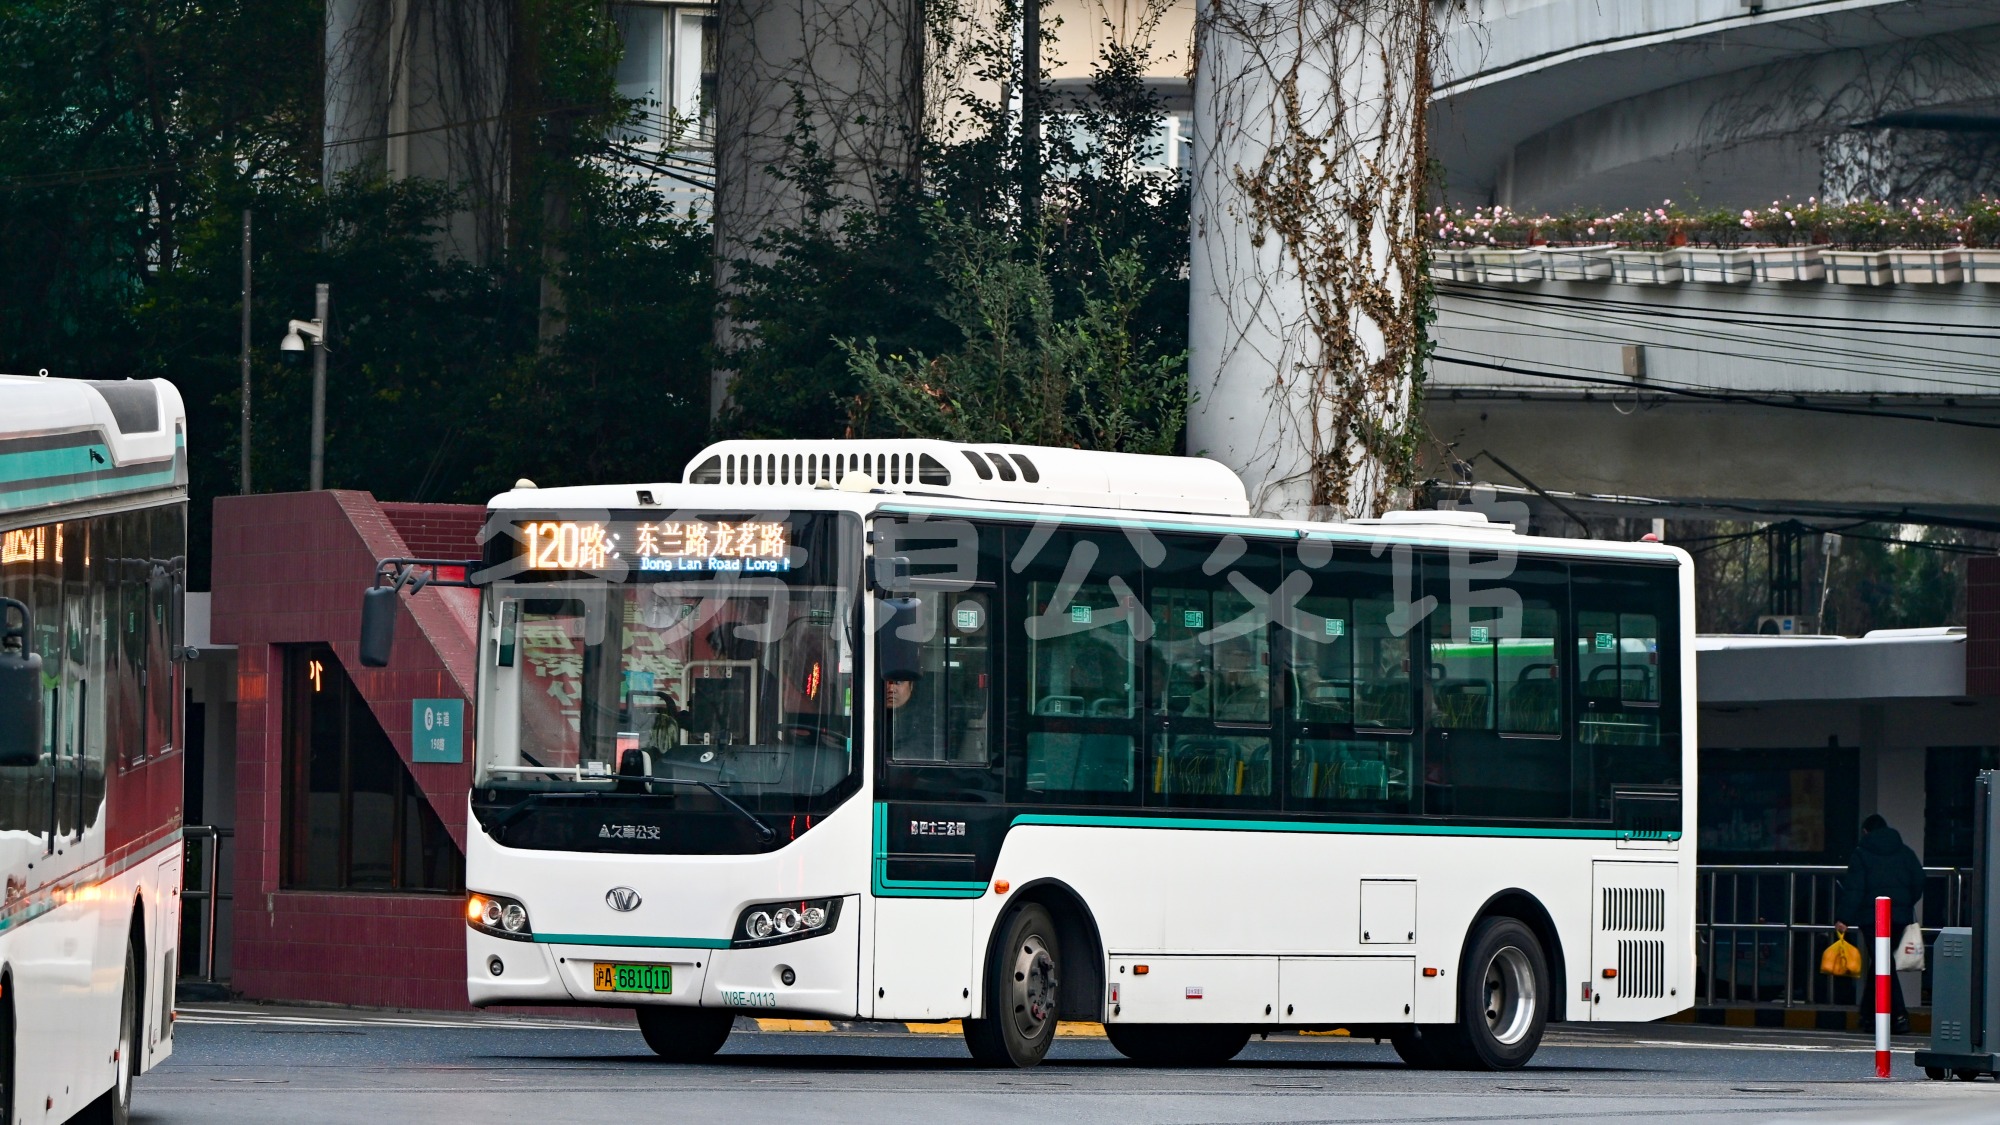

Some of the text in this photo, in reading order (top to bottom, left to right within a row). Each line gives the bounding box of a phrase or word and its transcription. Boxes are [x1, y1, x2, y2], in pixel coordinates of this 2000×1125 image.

[523, 521, 786, 569] 120路 东兰路龙茗路
[641, 557, 672, 571] Dong
[679, 557, 702, 570] Lan
[708, 557, 740, 570] Road
[746, 557, 777, 571] Long
[721, 991, 776, 1007] W8E-0113
